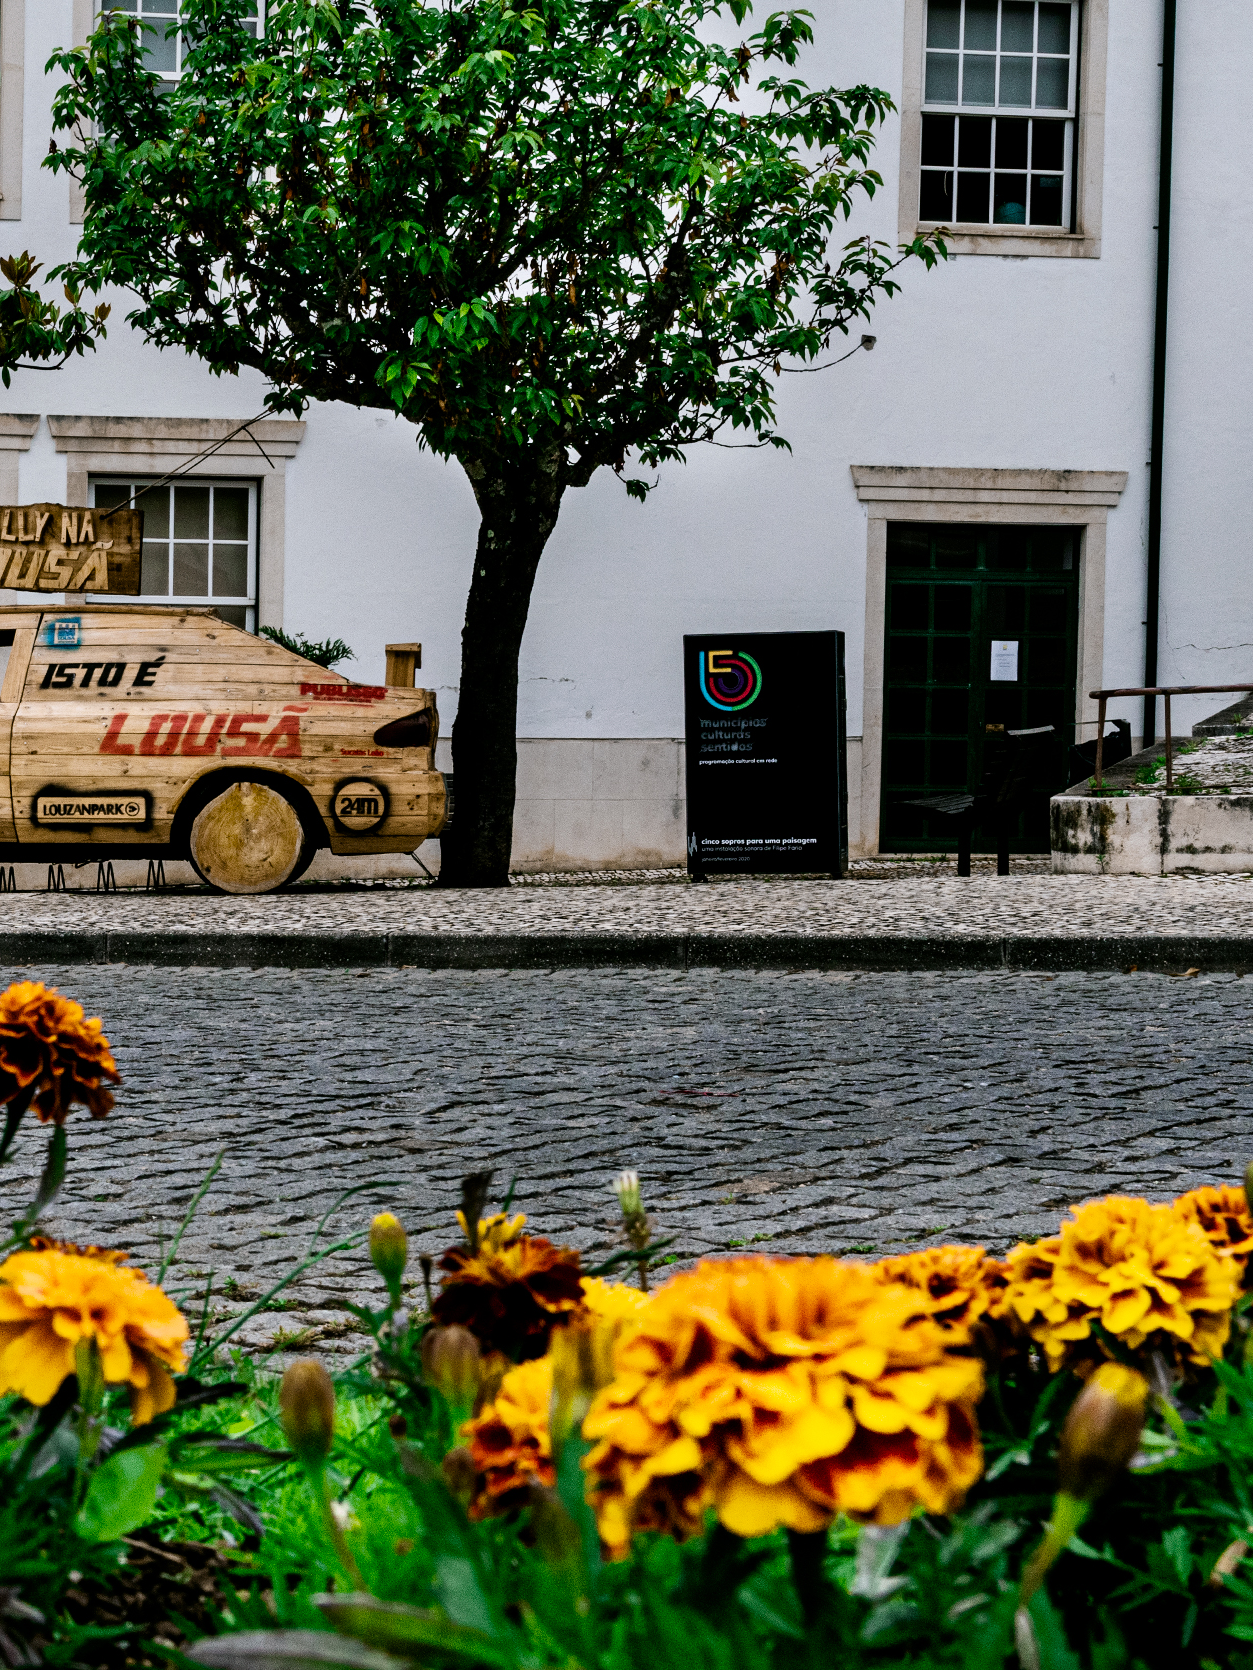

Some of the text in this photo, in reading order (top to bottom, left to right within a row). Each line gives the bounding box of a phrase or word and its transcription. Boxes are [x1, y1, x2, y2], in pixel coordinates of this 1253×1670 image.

[60, 511, 95, 544] NA
[39, 655, 167, 690] ISTO É
[99, 704, 311, 759] LOUSÃ
[700, 730, 751, 740] culturas
[700, 741, 753, 752] sentidos
[42, 802, 125, 817] LOUZANPARK
[721, 838, 745, 846] sopros
[746, 838, 764, 846] para
[782, 836, 817, 846] paisagem
